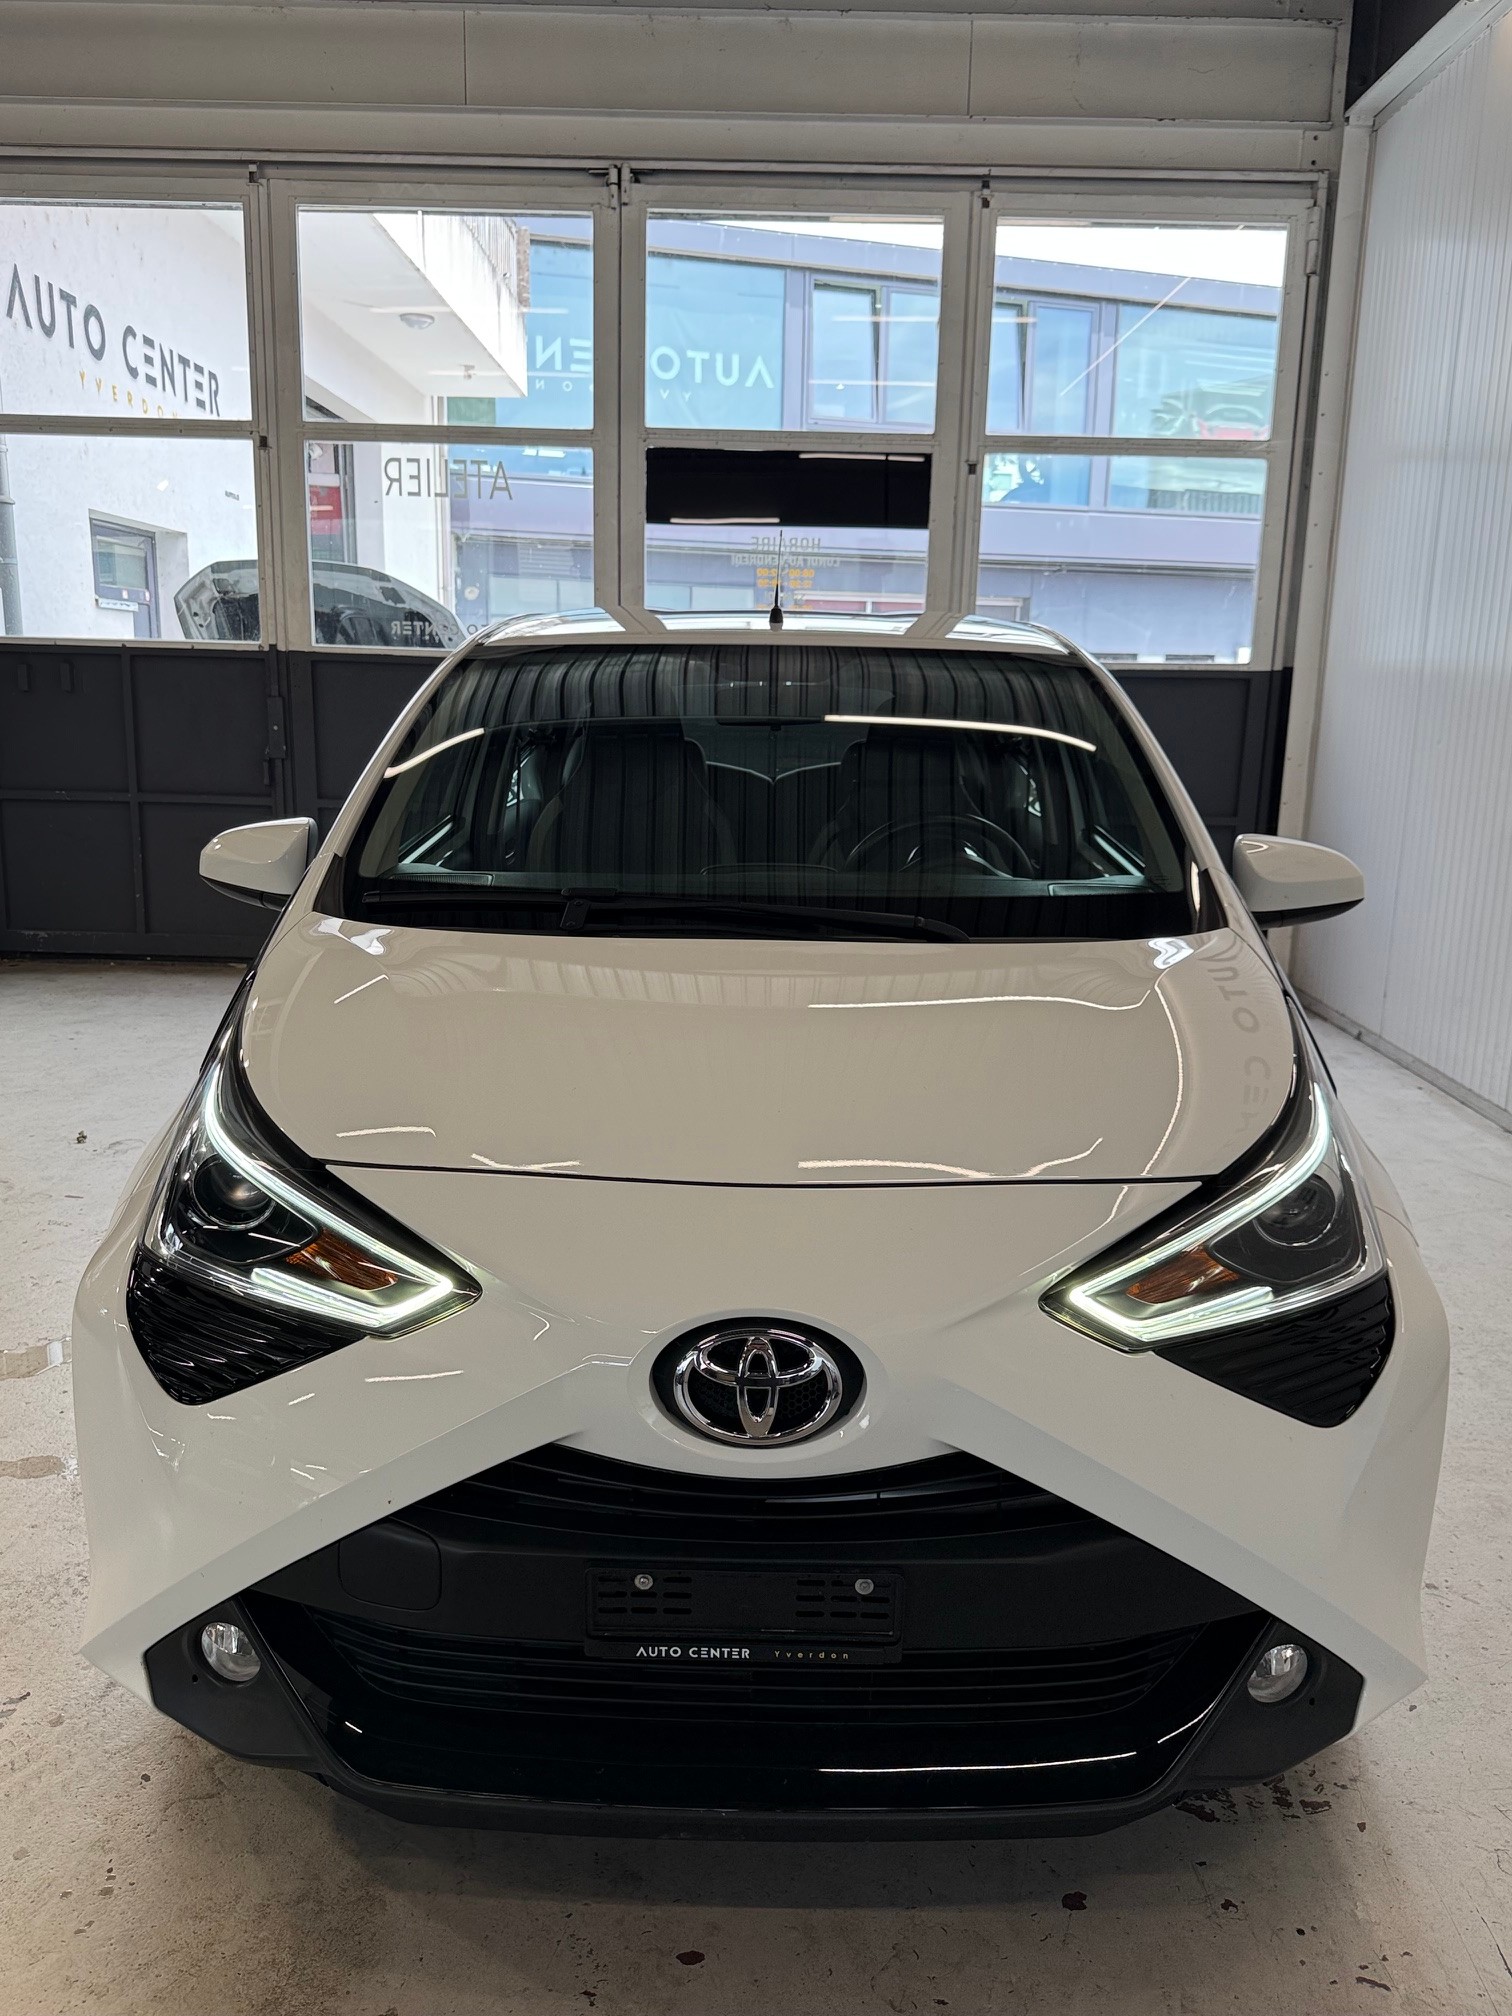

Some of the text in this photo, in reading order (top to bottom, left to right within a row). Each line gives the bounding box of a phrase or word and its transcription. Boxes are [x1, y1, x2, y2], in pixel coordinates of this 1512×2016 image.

[6, 262, 221, 418] AUTO CENTER
[636, 1646, 849, 1660] AUTO CENTER Yverdon
